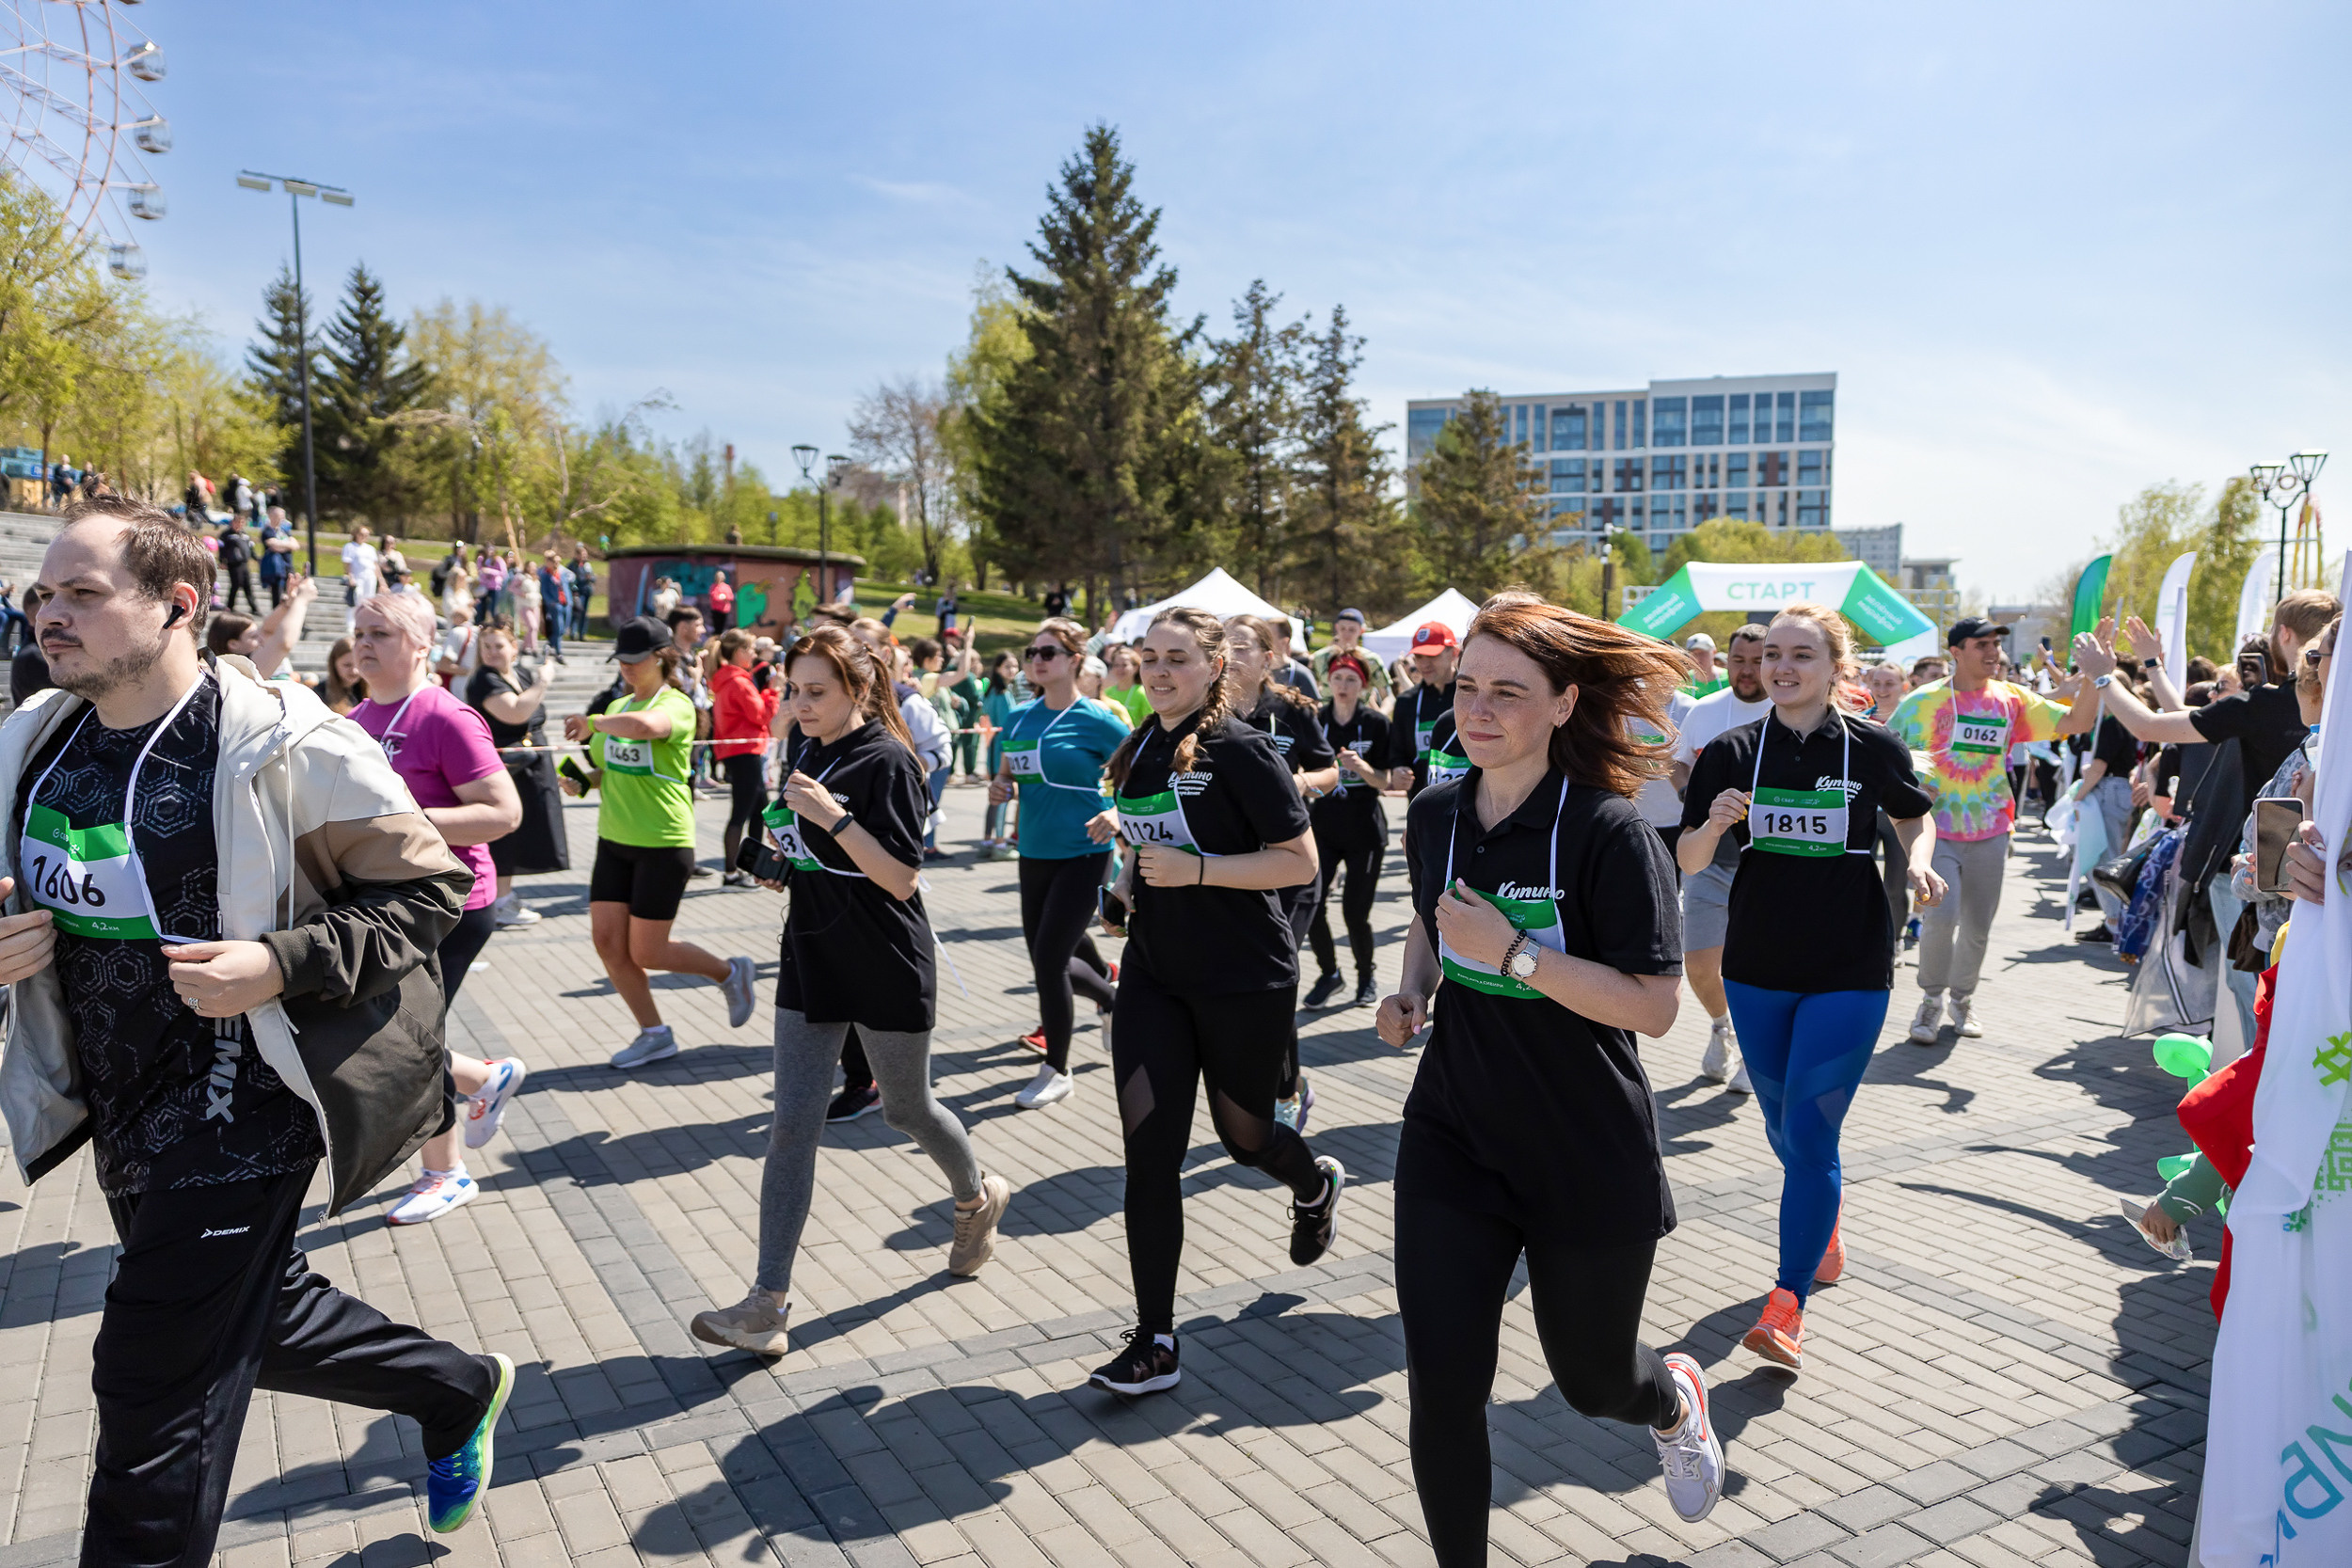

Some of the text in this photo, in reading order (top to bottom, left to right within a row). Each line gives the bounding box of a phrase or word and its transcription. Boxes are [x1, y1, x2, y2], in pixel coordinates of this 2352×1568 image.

[1726, 581, 1816, 600] СТАРТ
[1963, 727, 1997, 742] 0162
[1123, 819, 1174, 842] 1124
[1764, 813, 1828, 835] 1815
[32, 855, 105, 908] 1606
[1496, 880, 1565, 900] Купино
[206, 1017, 242, 1124] EMIX
[213, 1226, 251, 1238] DEMIX
